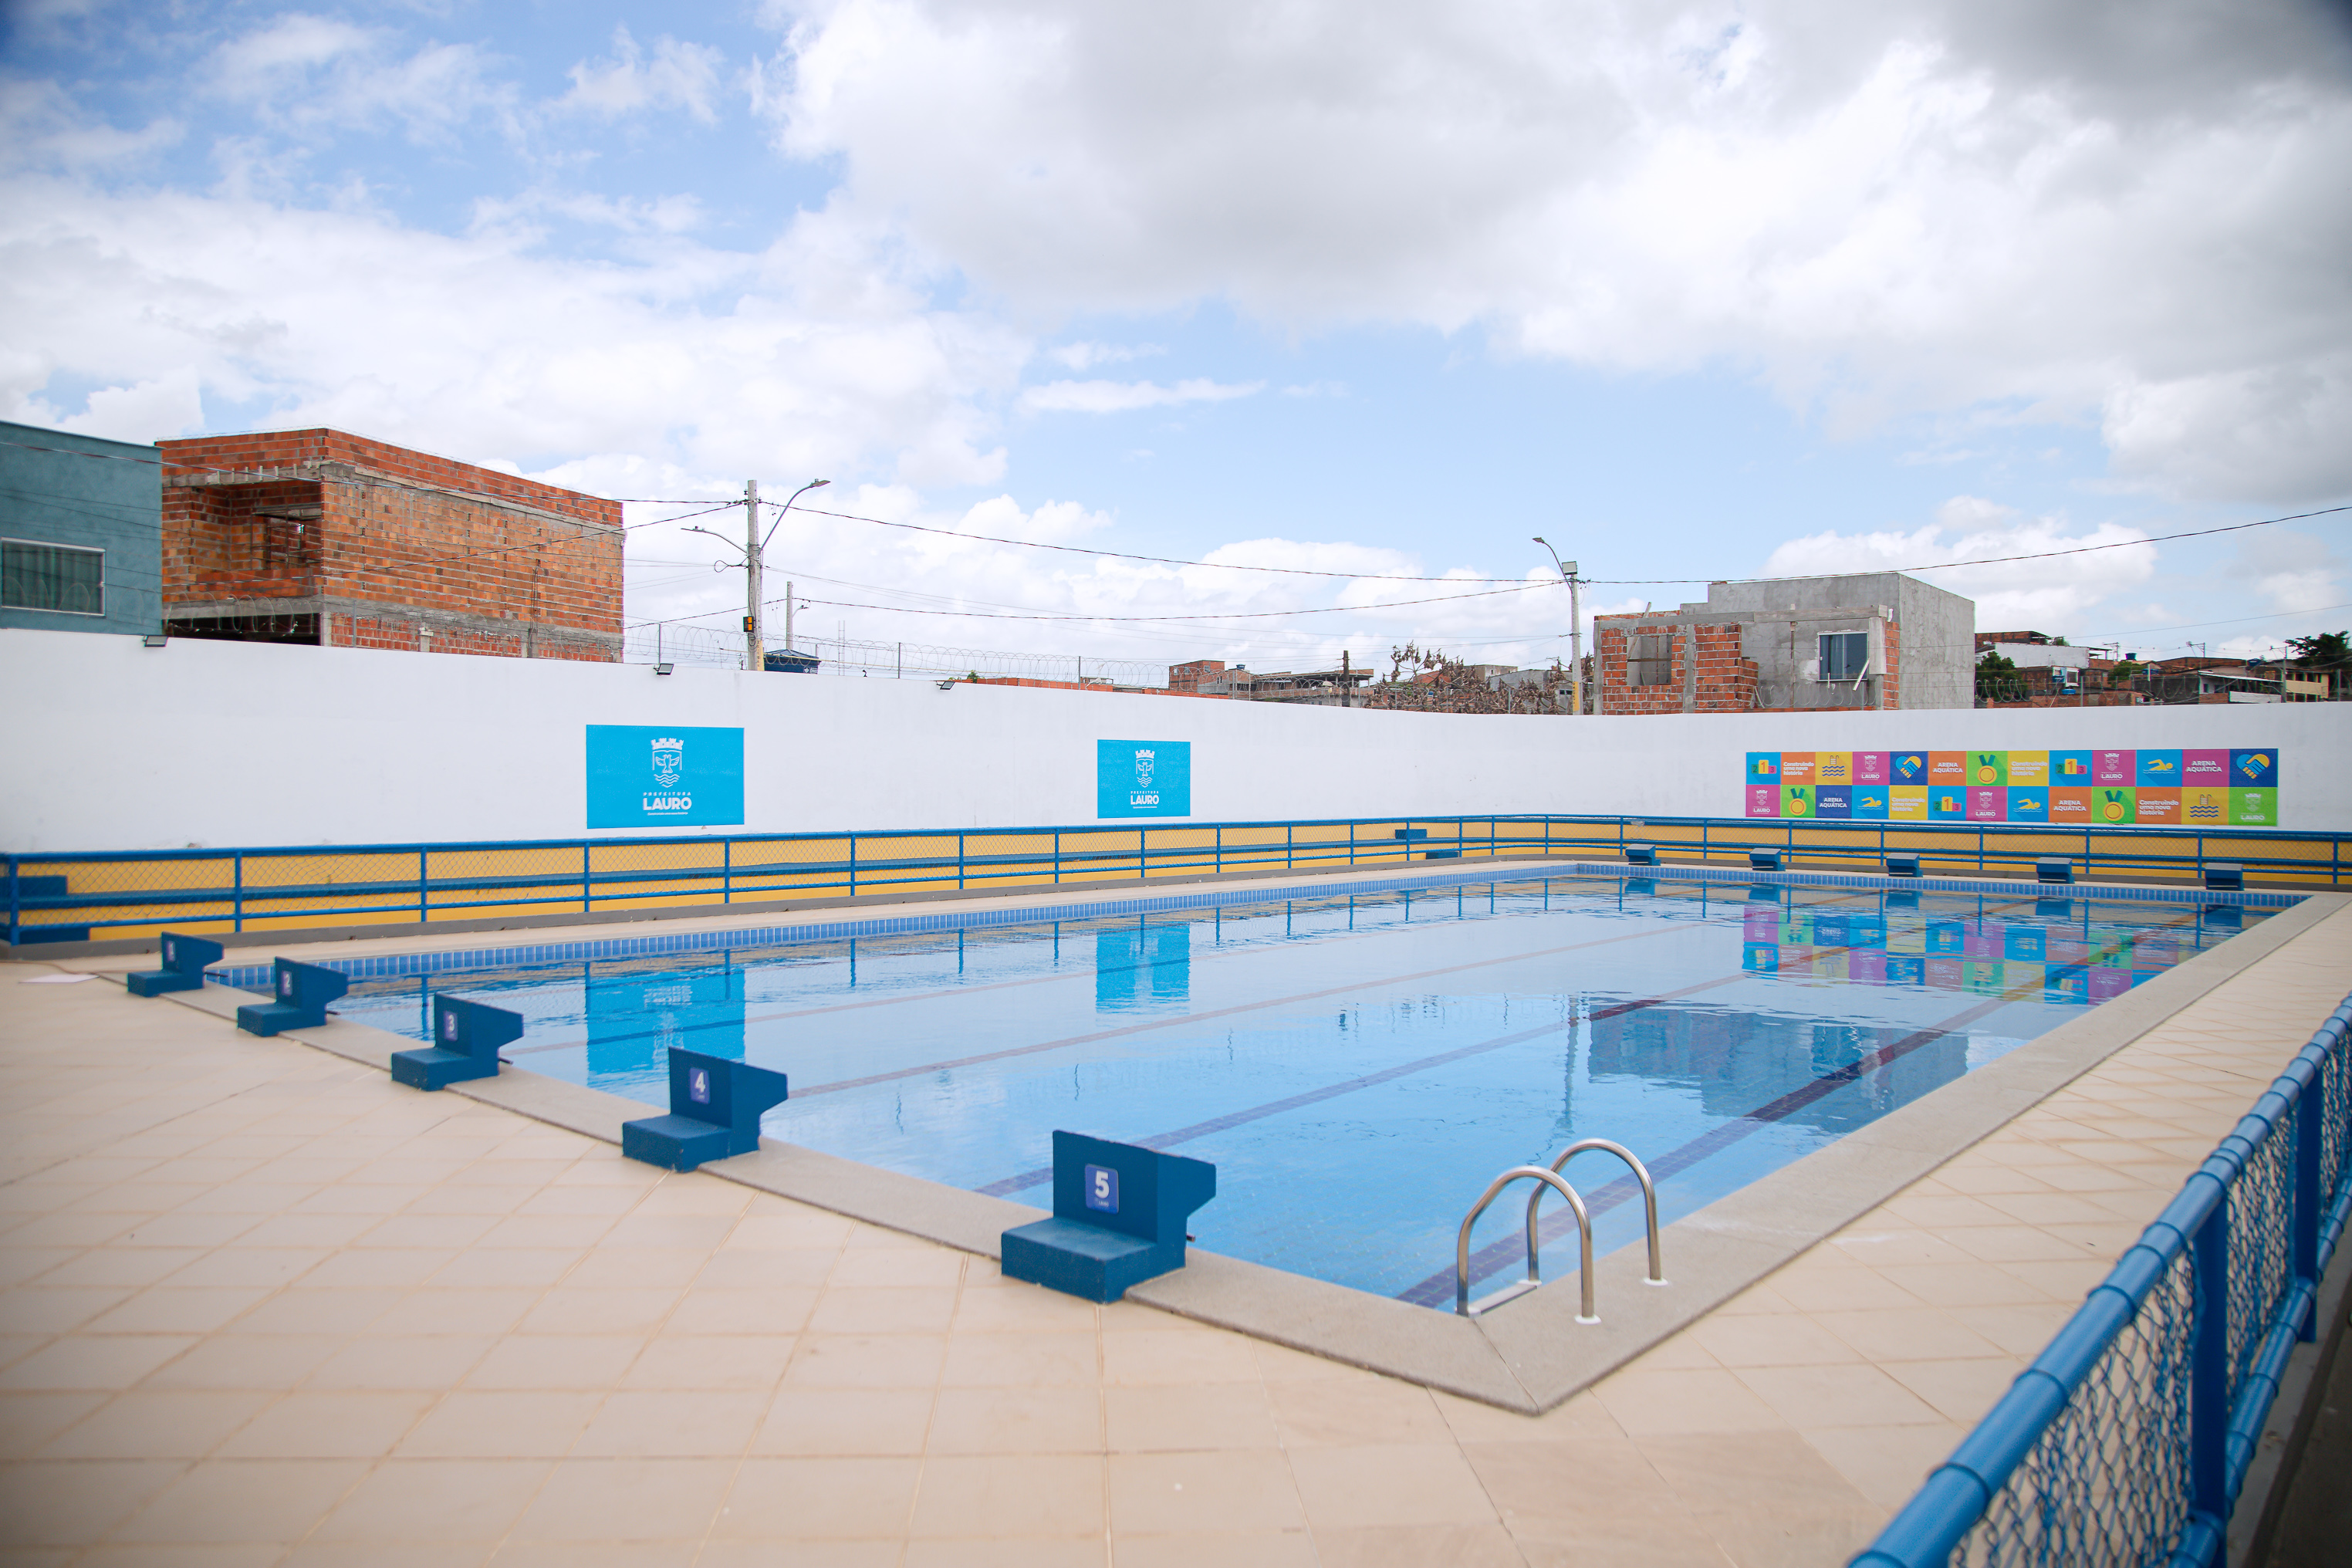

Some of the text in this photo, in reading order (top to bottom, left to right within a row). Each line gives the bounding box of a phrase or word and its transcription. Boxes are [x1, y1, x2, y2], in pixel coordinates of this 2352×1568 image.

[1760, 762, 1766, 773] 1
[2056, 765, 2063, 773] 2
[2068, 760, 2074, 773] 1
[2185, 765, 2222, 773] AQUÁTICA
[642, 797, 692, 810] LAURO
[1130, 795, 1160, 805] LAURO
[1944, 798, 1950, 810] 1
[285, 973, 291, 988] 2
[448, 1014, 455, 1032] 3
[695, 1071, 706, 1093] 4
[1095, 1170, 1110, 1199] 5
